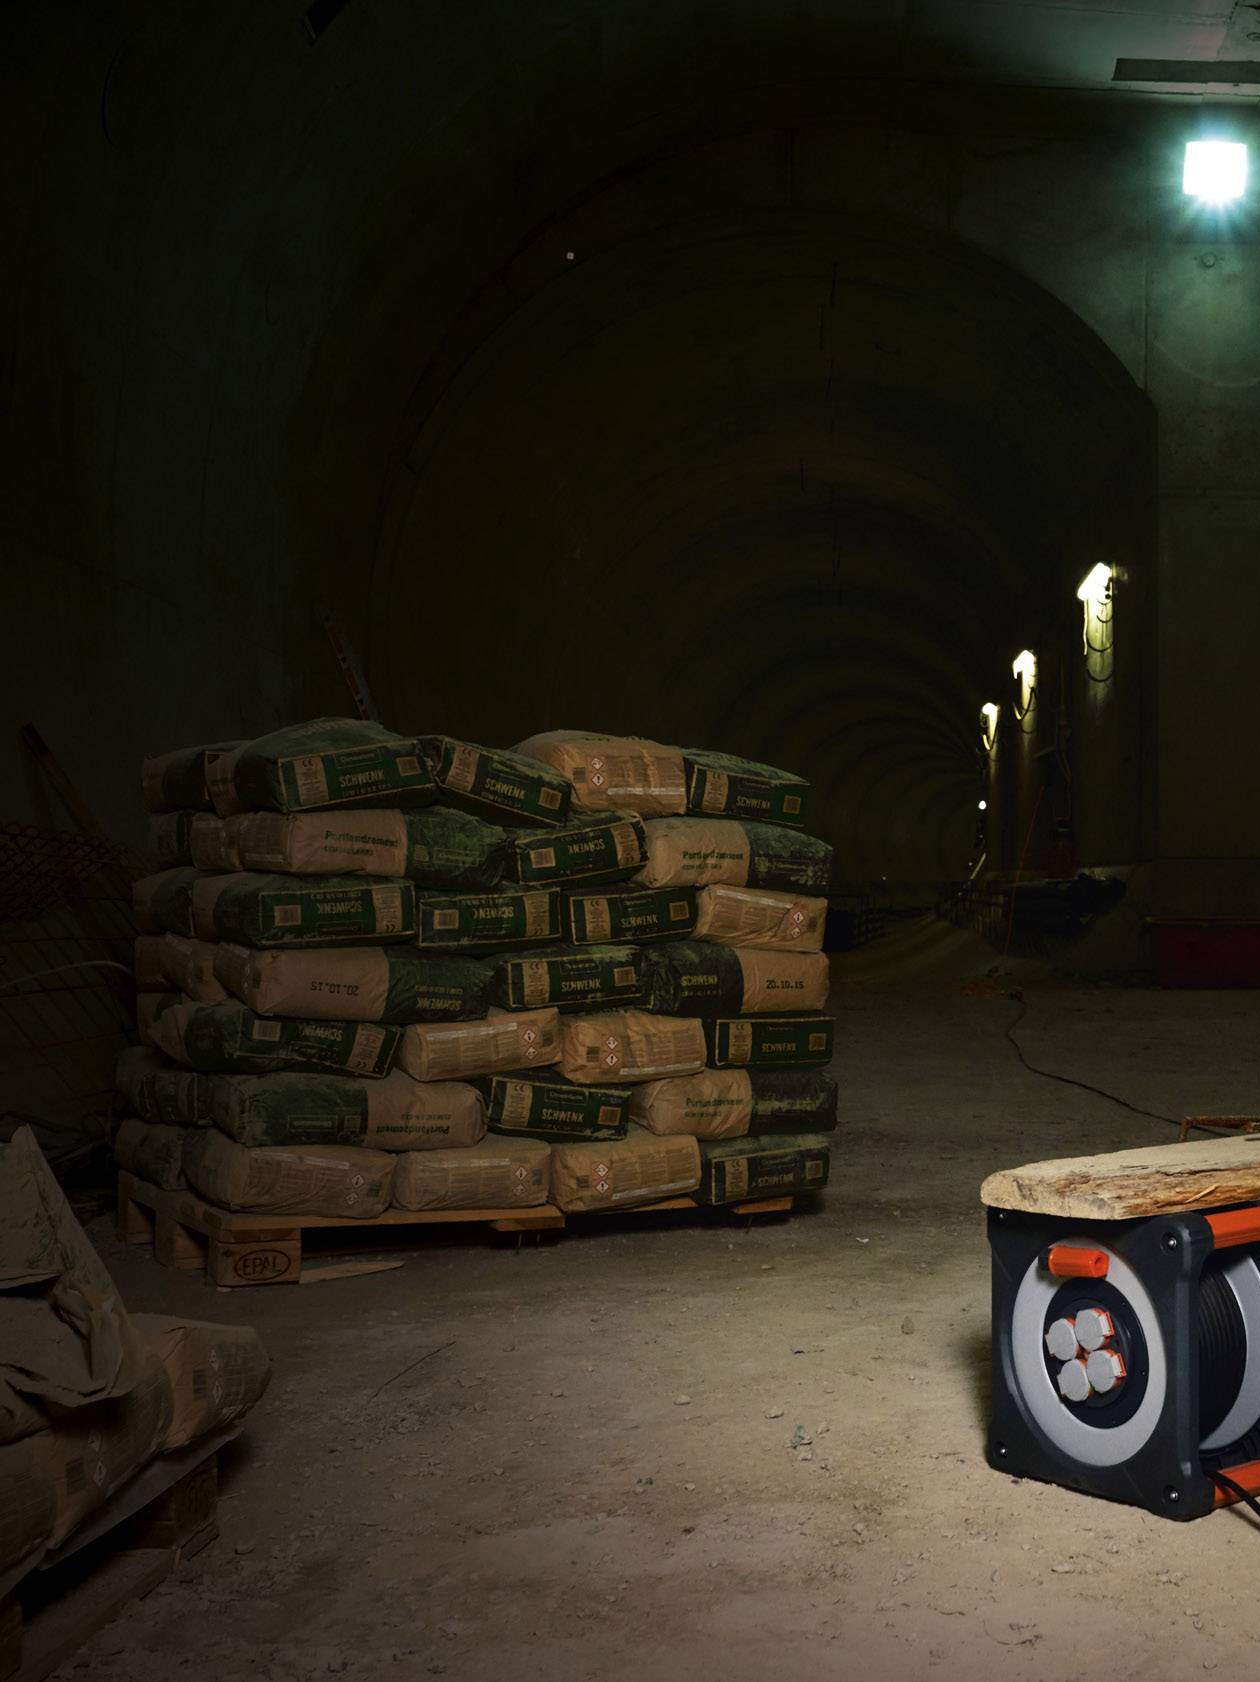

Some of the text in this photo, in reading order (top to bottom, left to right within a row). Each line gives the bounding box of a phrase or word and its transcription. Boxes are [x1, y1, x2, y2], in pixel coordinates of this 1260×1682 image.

[339, 769, 385, 788] SCHWENK
[484, 778, 527, 800] SCHWENK
[560, 979, 601, 992] SCHWENK
[542, 1108, 585, 1122] SCHWENK
[242, 1255, 283, 1276] EPAL
